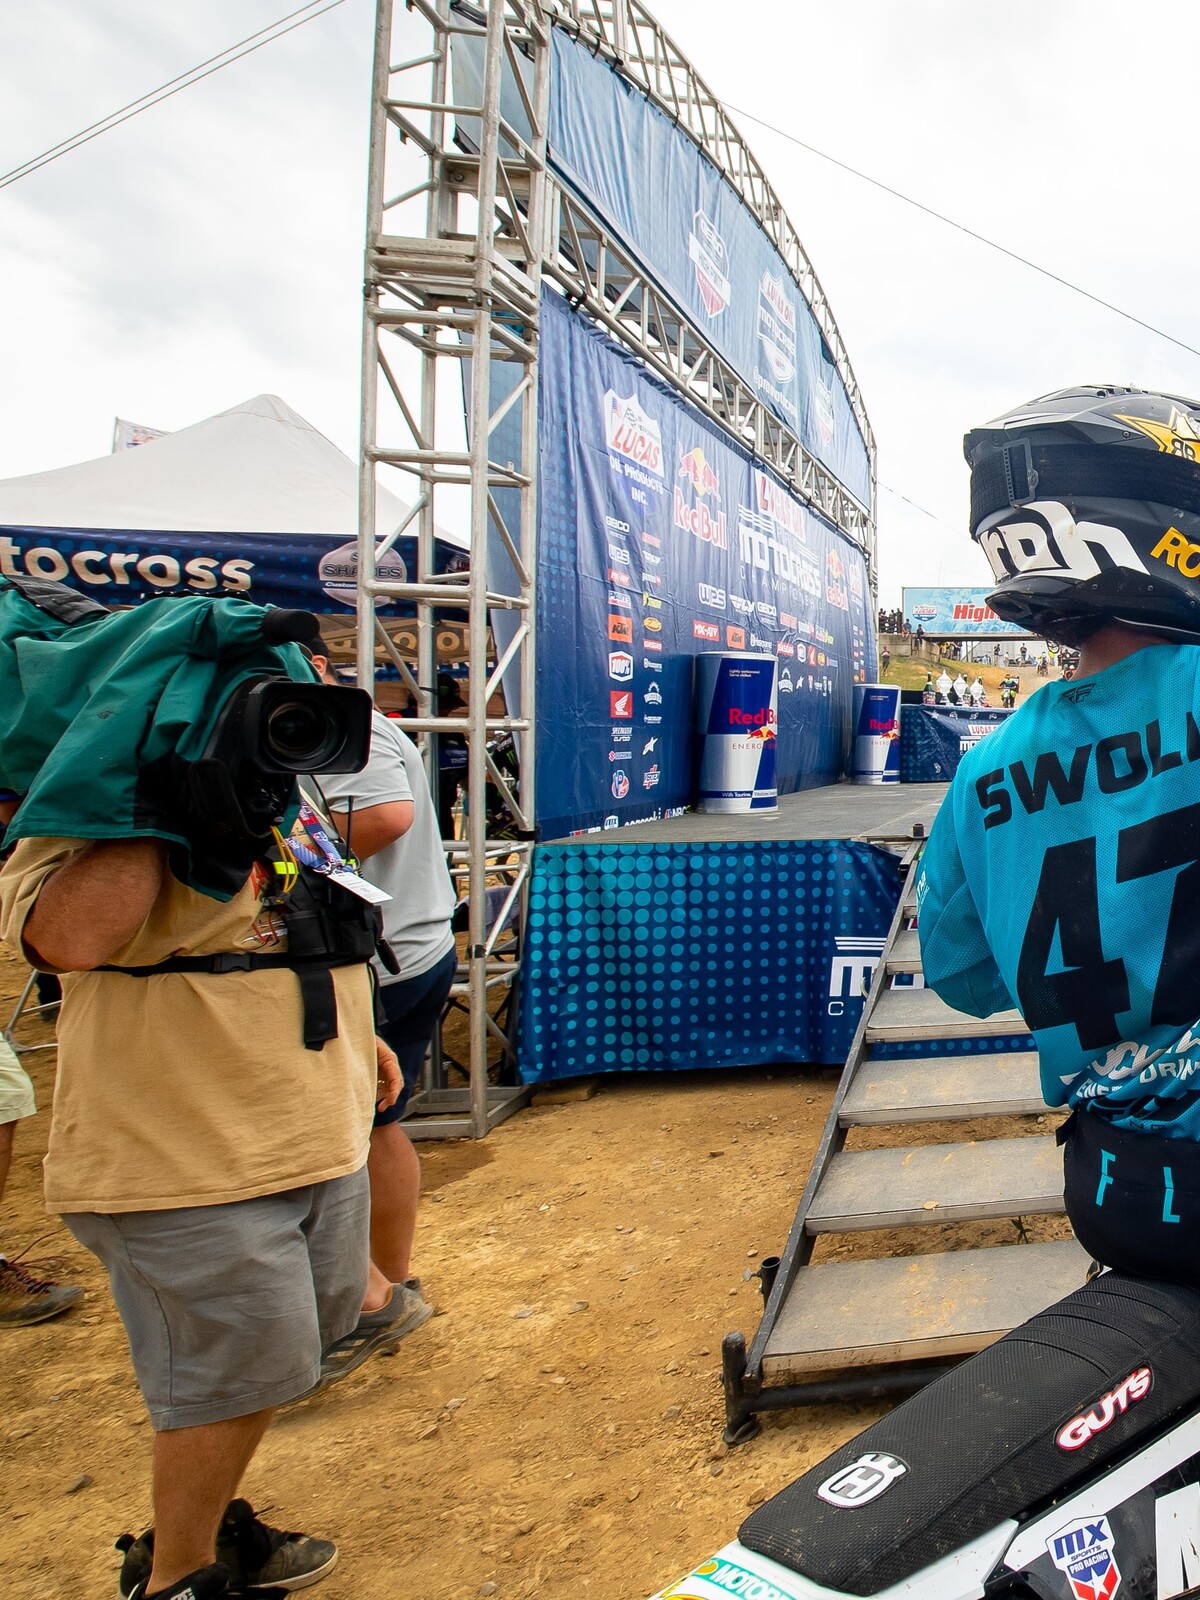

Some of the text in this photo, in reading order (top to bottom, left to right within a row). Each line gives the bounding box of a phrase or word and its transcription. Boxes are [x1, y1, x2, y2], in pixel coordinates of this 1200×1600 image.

[612, 424, 659, 468] LUCAS
[609, 455, 663, 494] OIL PRODUCTS
[323, 564, 402, 578] SHAES
[612, 622, 629, 635] KTM
[612, 659, 630, 674] 100%
[729, 708, 765, 724] Red
[870, 719, 892, 730] Red
[1059, 1366, 1151, 1449] GUTS
[1054, 1519, 1109, 1560] MX
[1070, 1552, 1109, 1574] PRO RACING
[1071, 1545, 1102, 1562] SPORTS
[710, 1564, 790, 1600] MOTOR
